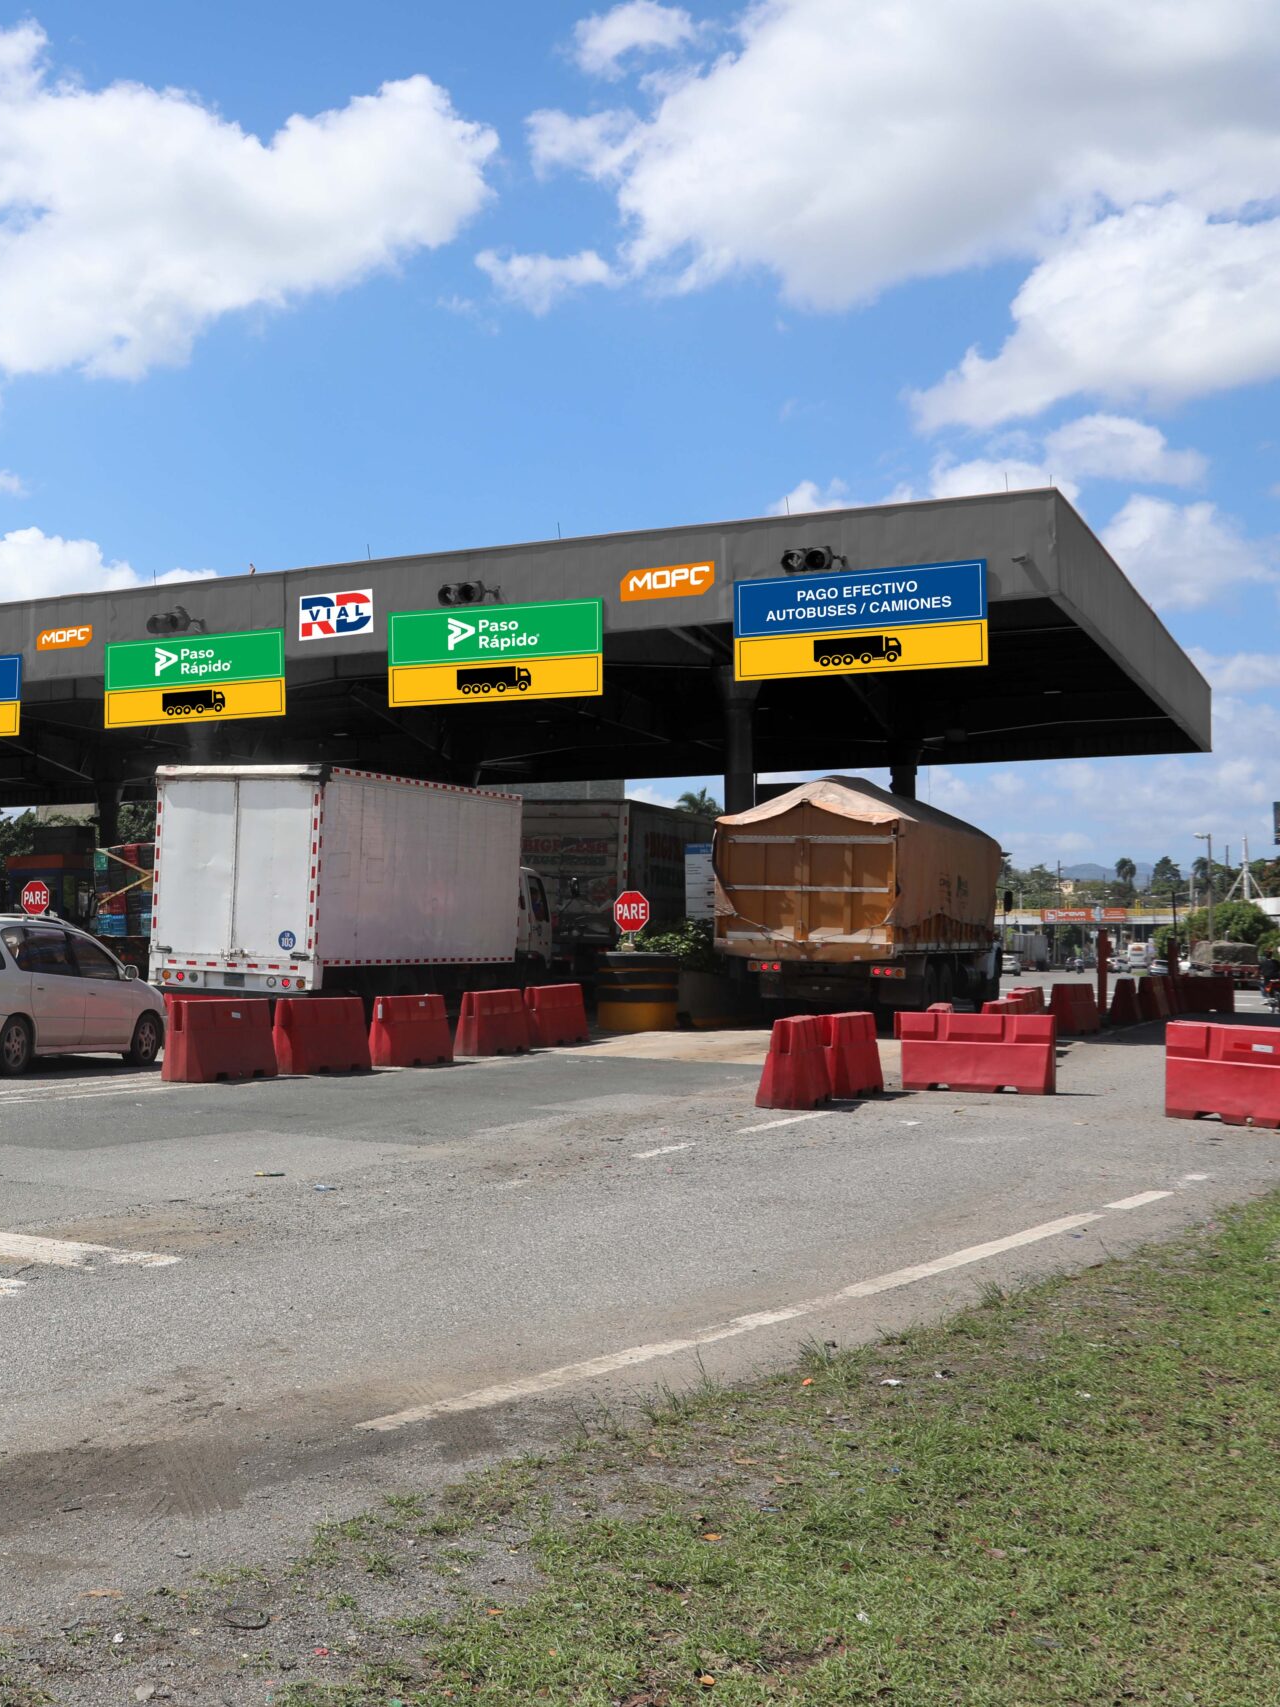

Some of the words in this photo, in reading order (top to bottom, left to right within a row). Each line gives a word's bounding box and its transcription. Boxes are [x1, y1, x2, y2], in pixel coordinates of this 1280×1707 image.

[629, 565, 710, 592] MOPC
[796, 587, 838, 602] PAGO
[842, 580, 918, 598] EFECTIVO
[308, 604, 364, 621] VIAL
[766, 603, 857, 622] AUTOBUSES
[860, 602, 867, 615] /
[869, 595, 952, 614] CAMIONES
[478, 619, 519, 633] Paso
[41, 627, 90, 645] MOPC
[478, 633, 538, 651] Rápido
[180, 648, 215, 660] Paso
[180, 659, 229, 676] Rápido
[23, 890, 47, 905] PARE
[616, 902, 646, 920] PARE
[281, 937, 294, 948] 103
